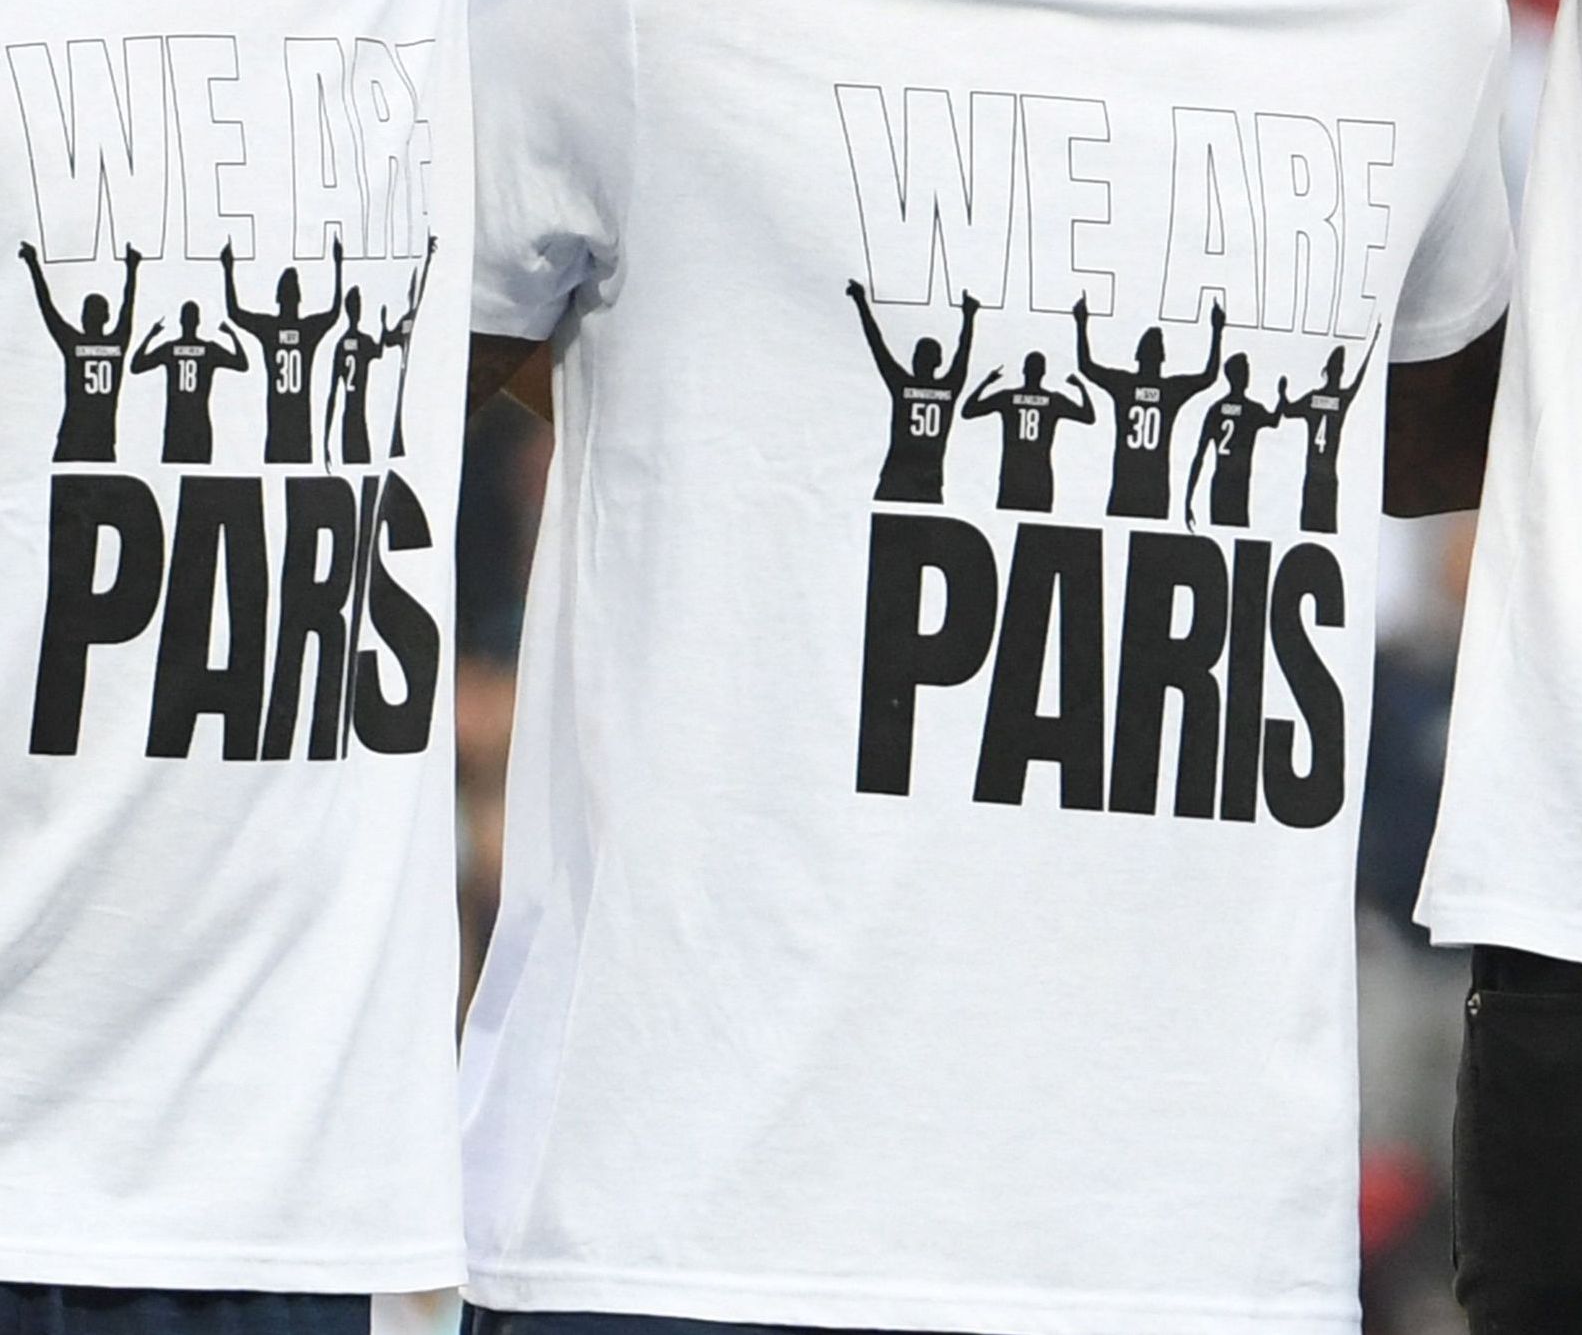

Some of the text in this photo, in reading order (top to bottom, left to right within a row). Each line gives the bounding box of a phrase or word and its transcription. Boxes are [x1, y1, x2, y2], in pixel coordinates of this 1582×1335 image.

[6, 34, 255, 264] WE
[834, 84, 1396, 339] WE ARE
[84, 360, 112, 394] 50
[178, 359, 198, 393] 18
[276, 349, 301, 393] 30
[344, 354, 356, 392] 2
[910, 403, 941, 437] 50
[1018, 408, 1040, 441] 18
[1126, 406, 1161, 450] 30
[1218, 419, 1234, 456] 2
[1314, 414, 1327, 454] 4
[29, 470, 441, 761] PARIS
[855, 512, 1346, 829] PARIS
